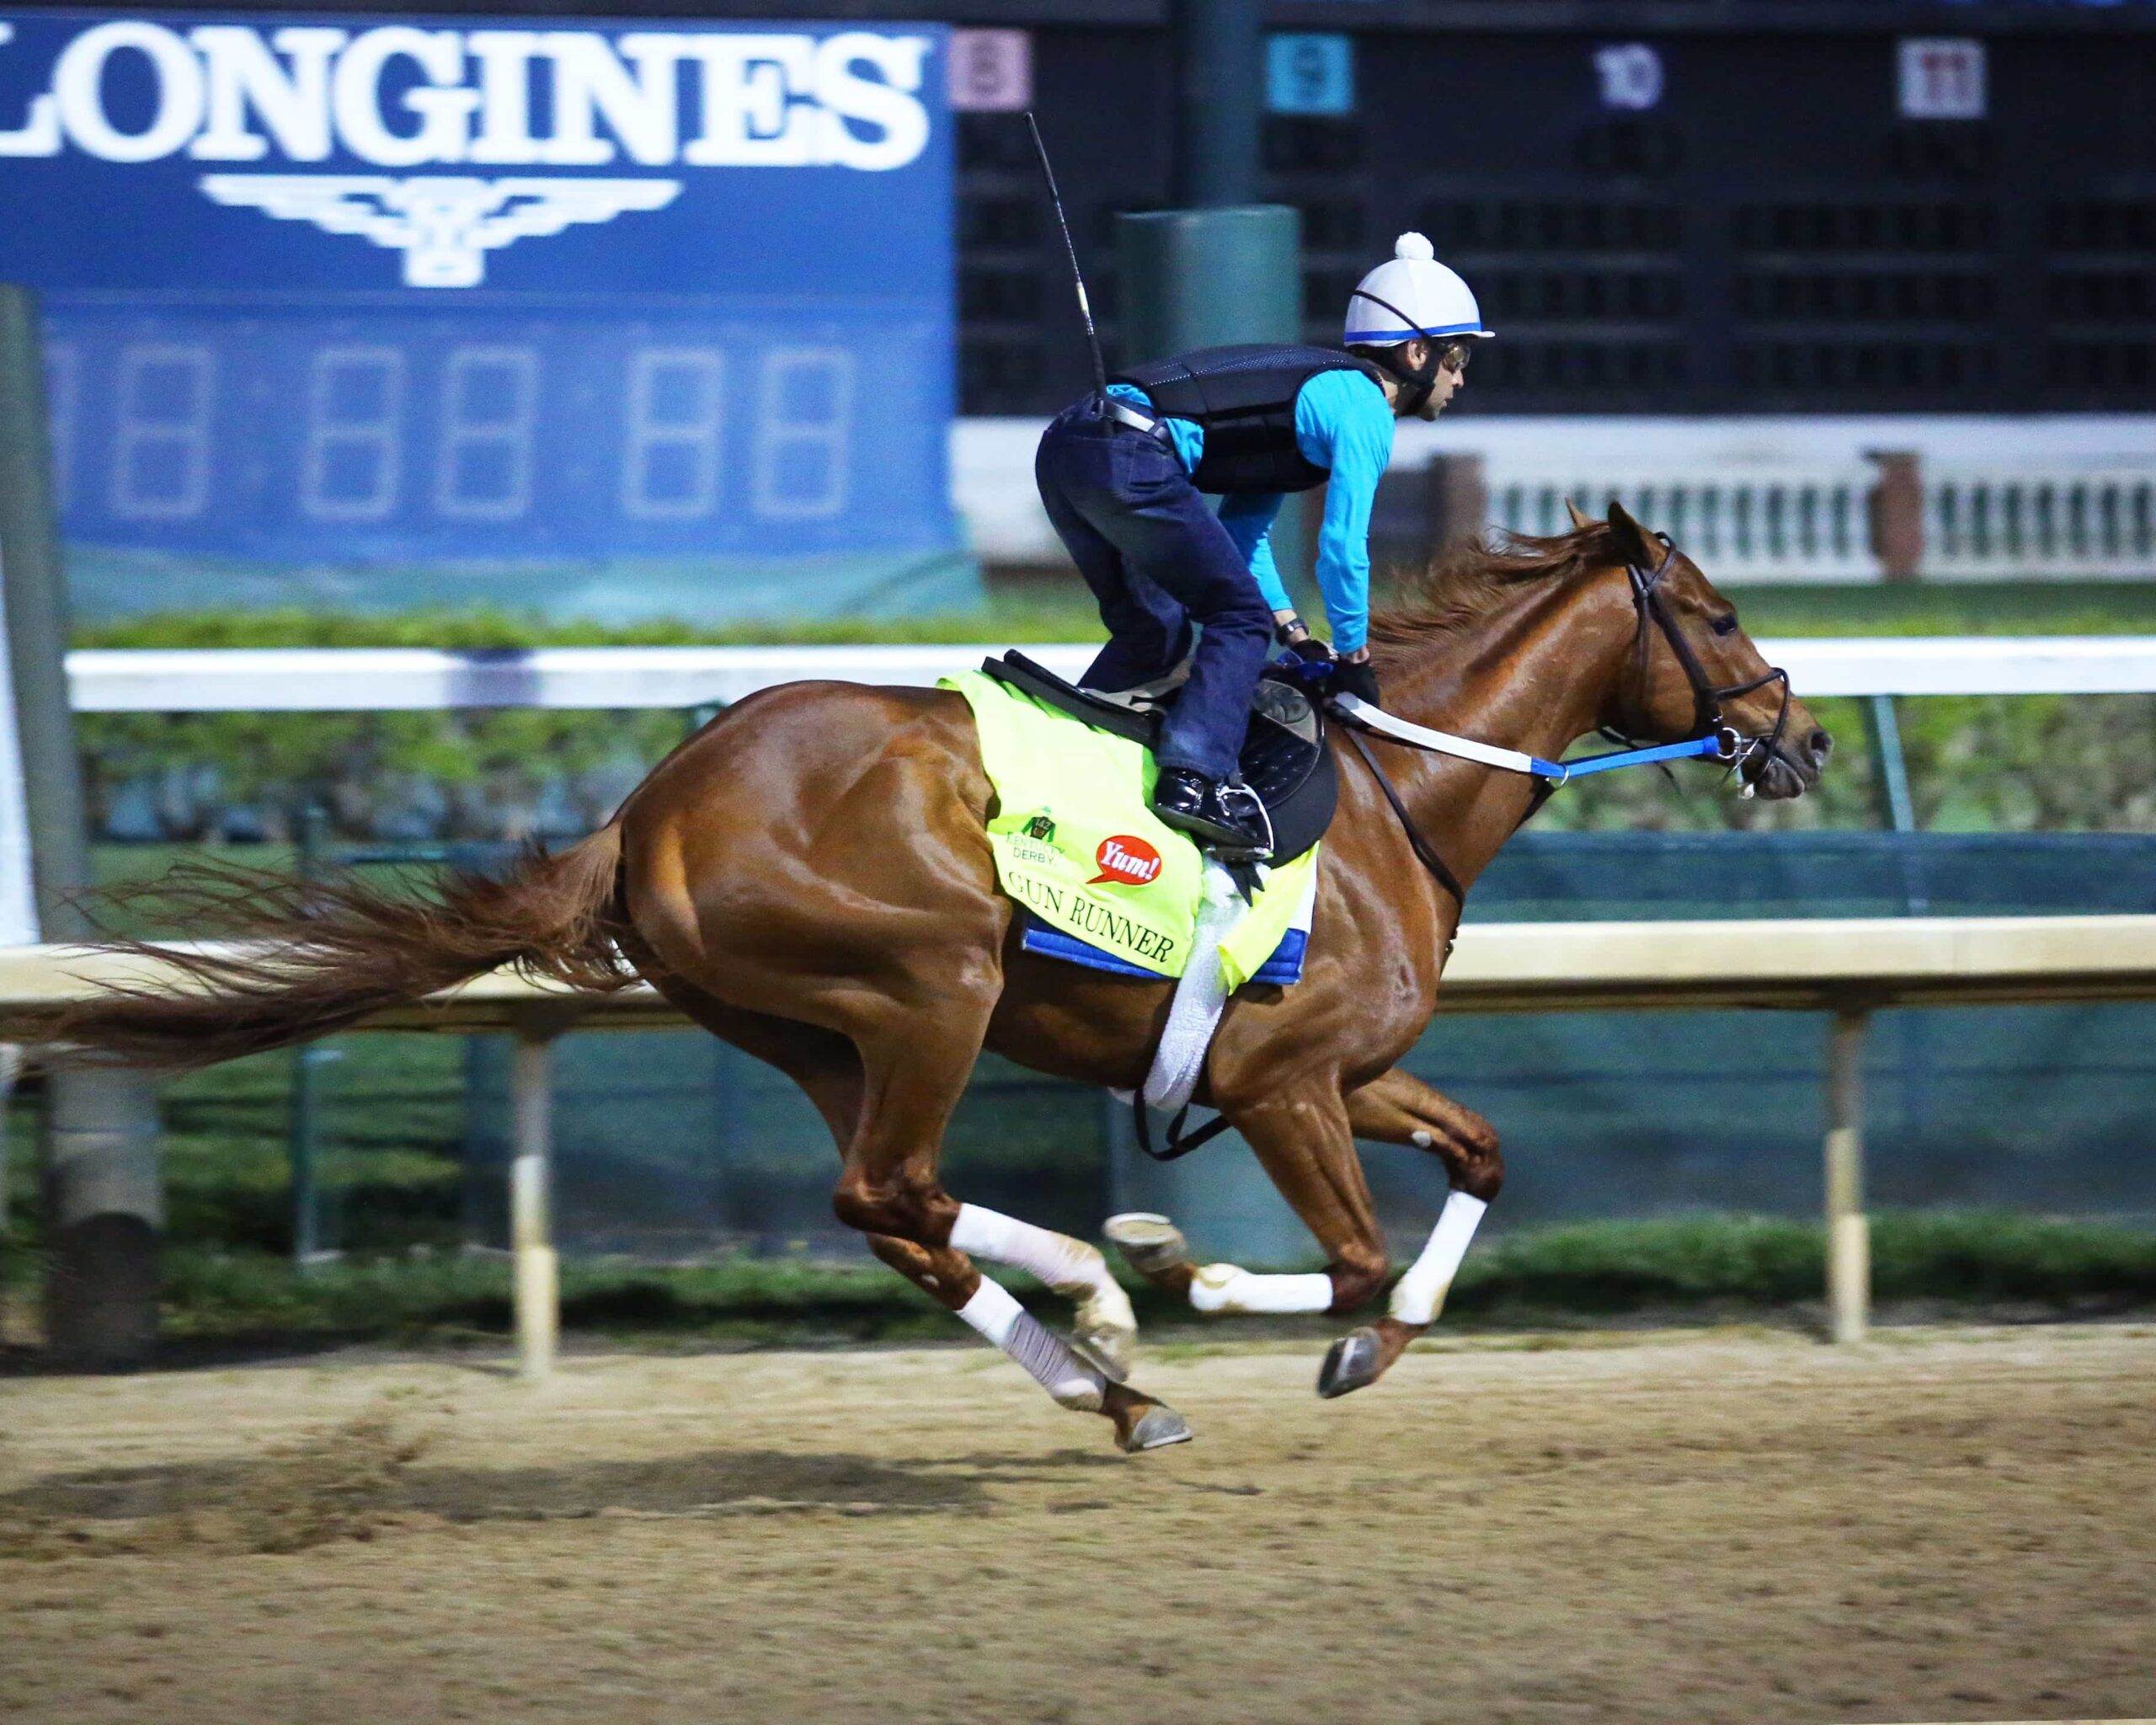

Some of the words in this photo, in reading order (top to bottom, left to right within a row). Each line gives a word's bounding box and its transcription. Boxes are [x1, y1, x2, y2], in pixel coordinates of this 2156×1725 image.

[0, 21, 930, 170] LONGINES
[1593, 42, 1664, 110] 10
[1921, 52, 1967, 101] 11
[1013, 846, 1055, 865] DERBY
[1100, 840, 1160, 880] Yum!
[1008, 872, 1064, 914] GUN
[1070, 896, 1175, 963] RUNNER
